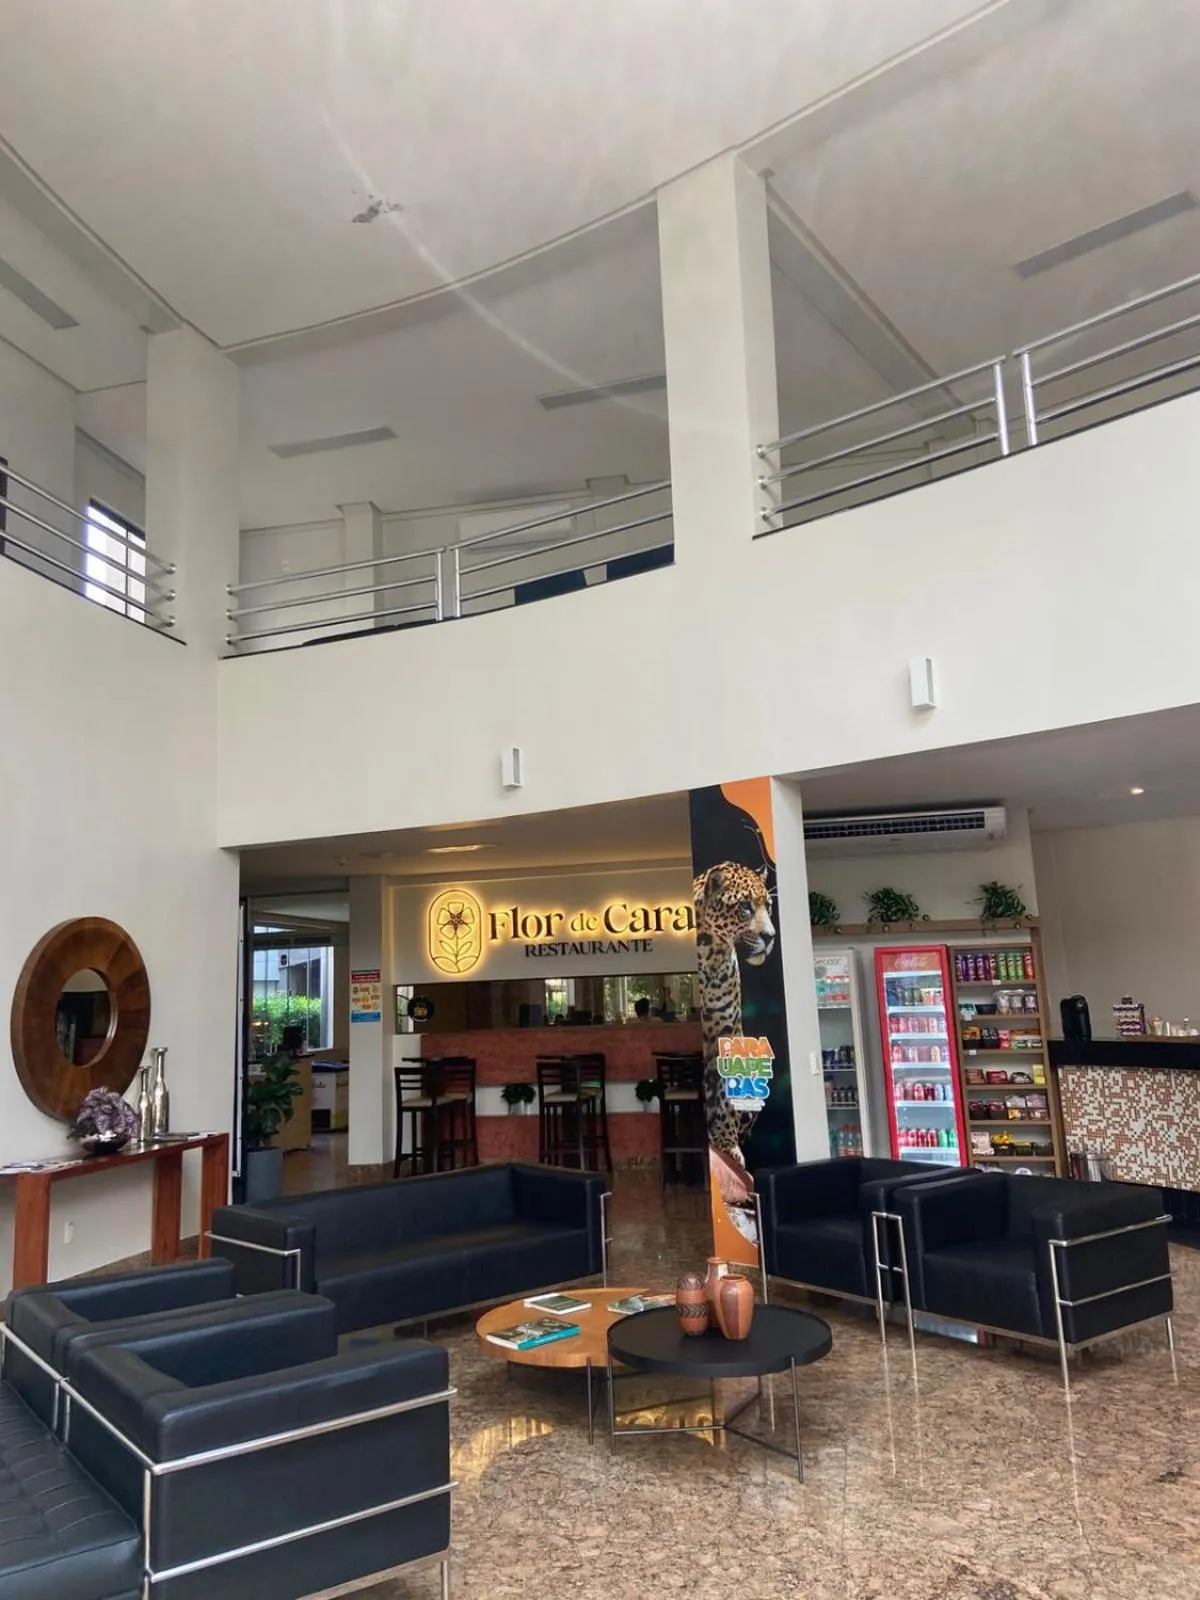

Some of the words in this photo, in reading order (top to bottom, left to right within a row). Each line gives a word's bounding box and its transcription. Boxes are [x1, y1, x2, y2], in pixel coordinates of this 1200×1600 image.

[488, 906, 564, 940] Flor
[570, 912, 597, 931] de
[604, 903, 697, 934] Cara
[524, 938, 653, 958] RESTAURANTE
